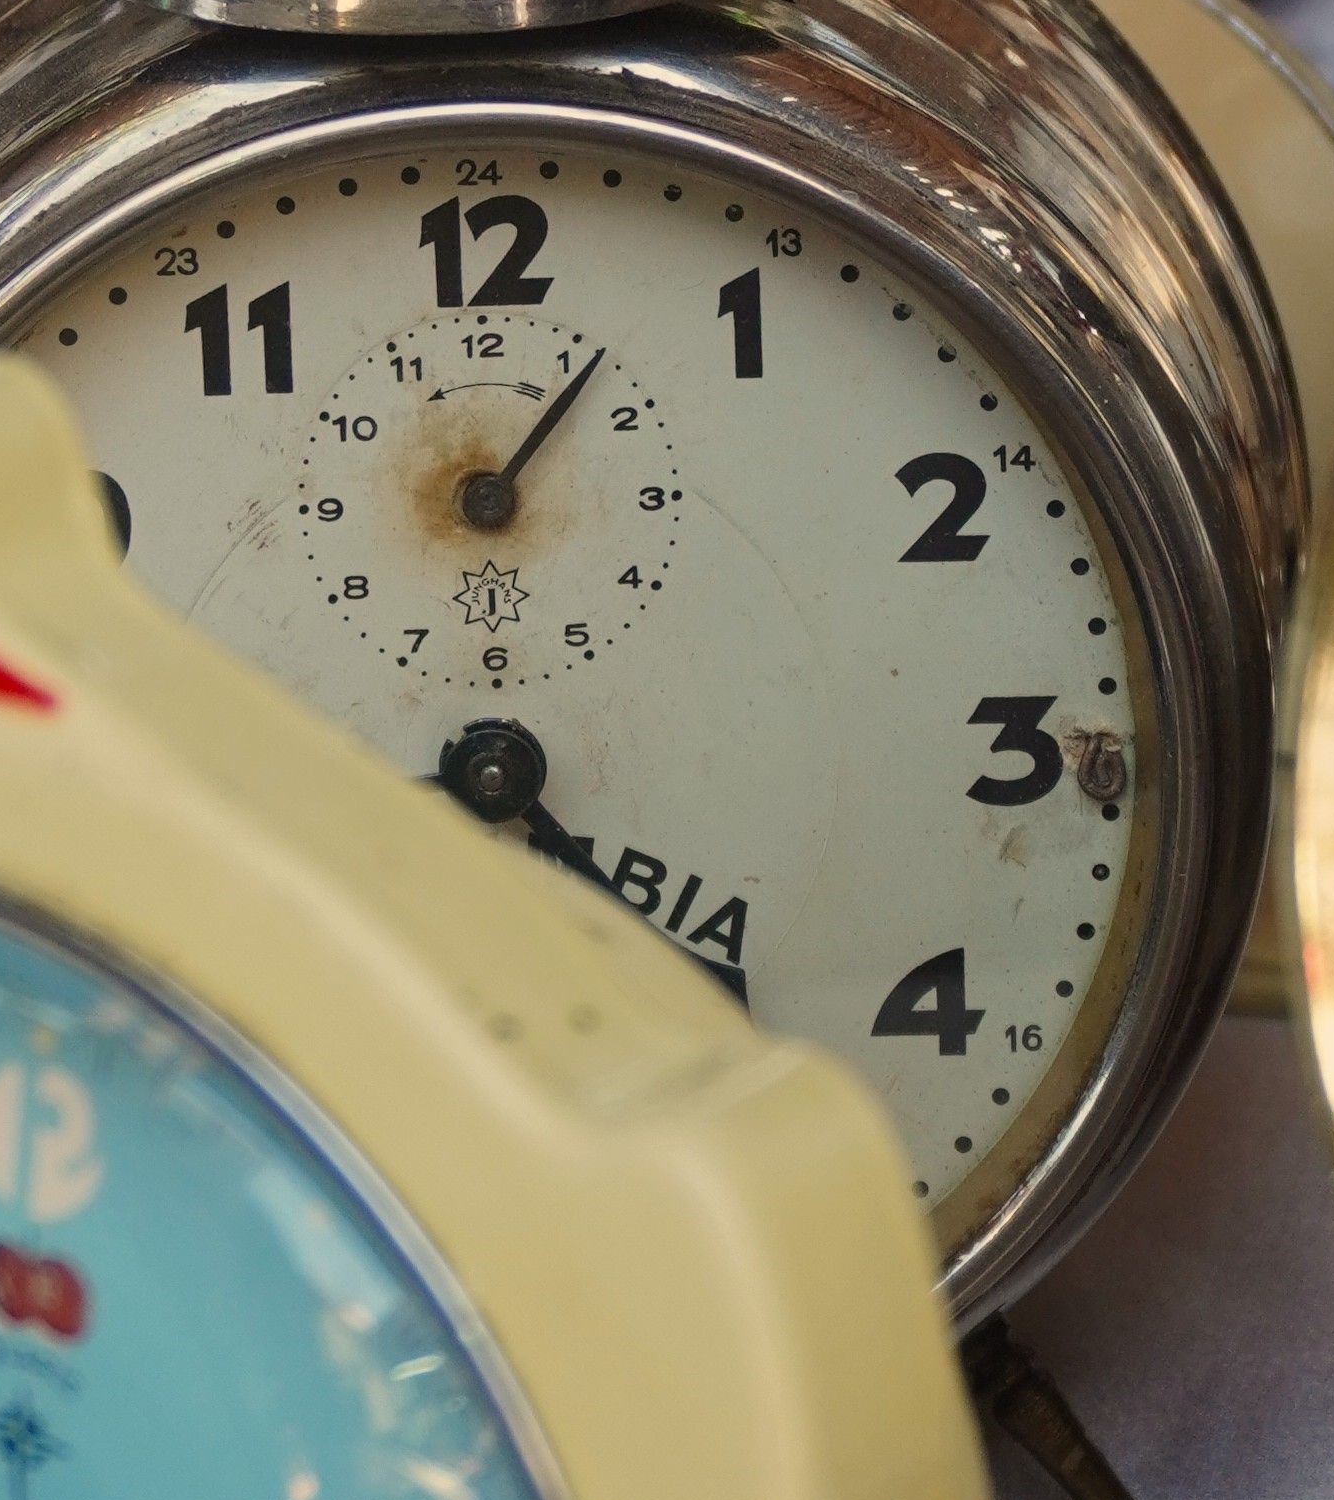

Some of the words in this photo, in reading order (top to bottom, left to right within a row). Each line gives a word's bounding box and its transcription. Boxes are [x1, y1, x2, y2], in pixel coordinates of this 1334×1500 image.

[456, 158, 503, 187] 24
[418, 194, 555, 309] 12
[766, 228, 803, 258] 13
[154, 246, 200, 277] 23
[717, 267, 764, 379] 1
[183, 280, 294, 397] 11
[461, 332, 506, 359] 12
[390, 355, 424, 383] 11
[556, 350, 570, 375] 1
[330, 415, 379, 443] 10
[609, 406, 640, 432] 2
[992, 445, 1037, 473] 14
[317, 497, 345, 522] 9
[638, 486, 666, 512] 3
[893, 451, 991, 563] 2
[342, 574, 369, 600] 8
[471, 577, 512, 606] JUNGHANS
[617, 565, 644, 590] 4
[403, 628, 430, 654] 7
[564, 622, 591, 647] 5
[482, 646, 509, 672] 6
[966, 695, 1065, 807] 3
[870, 946, 986, 1057] 4
[1003, 1023, 1044, 1054] 16
